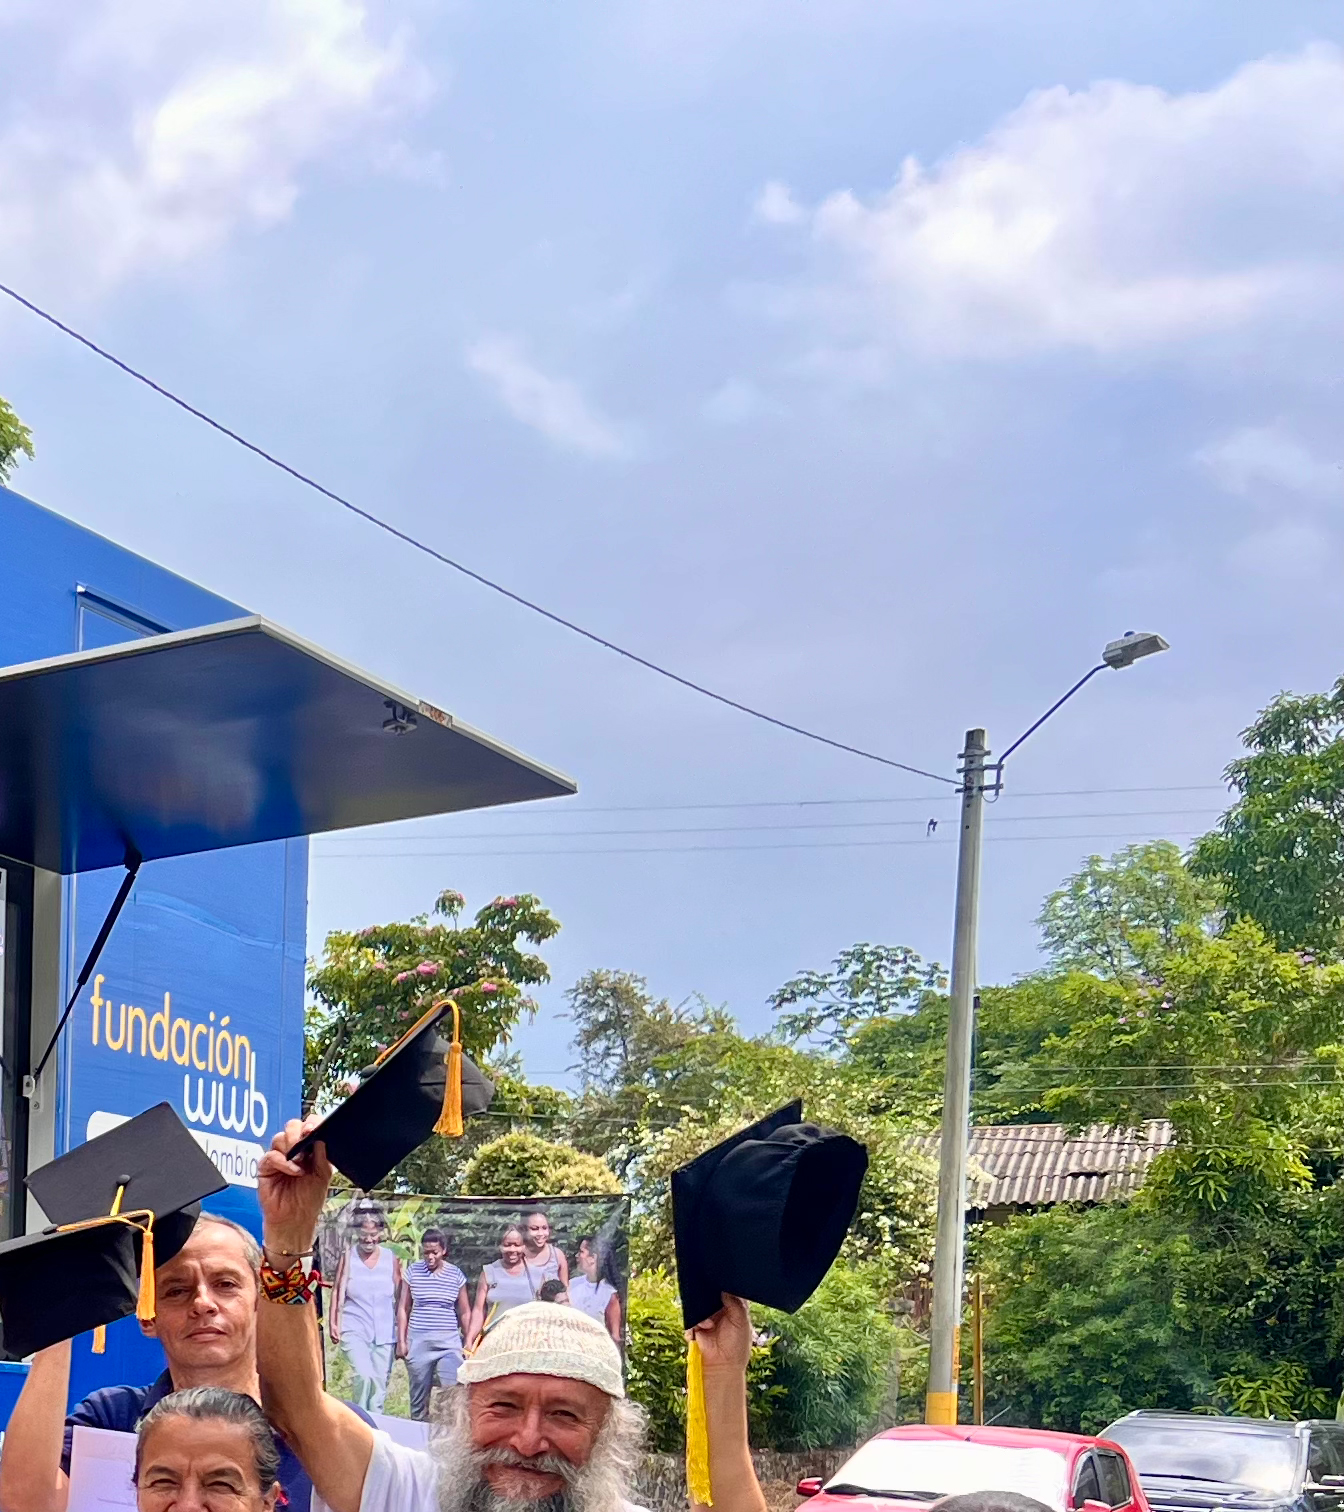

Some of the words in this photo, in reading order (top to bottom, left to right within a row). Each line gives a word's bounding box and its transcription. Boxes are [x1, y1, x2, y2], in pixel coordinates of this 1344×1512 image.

[90, 974, 250, 1082] fundación
[184, 1052, 268, 1137] wwb
[205, 1139, 258, 1179] lombia
